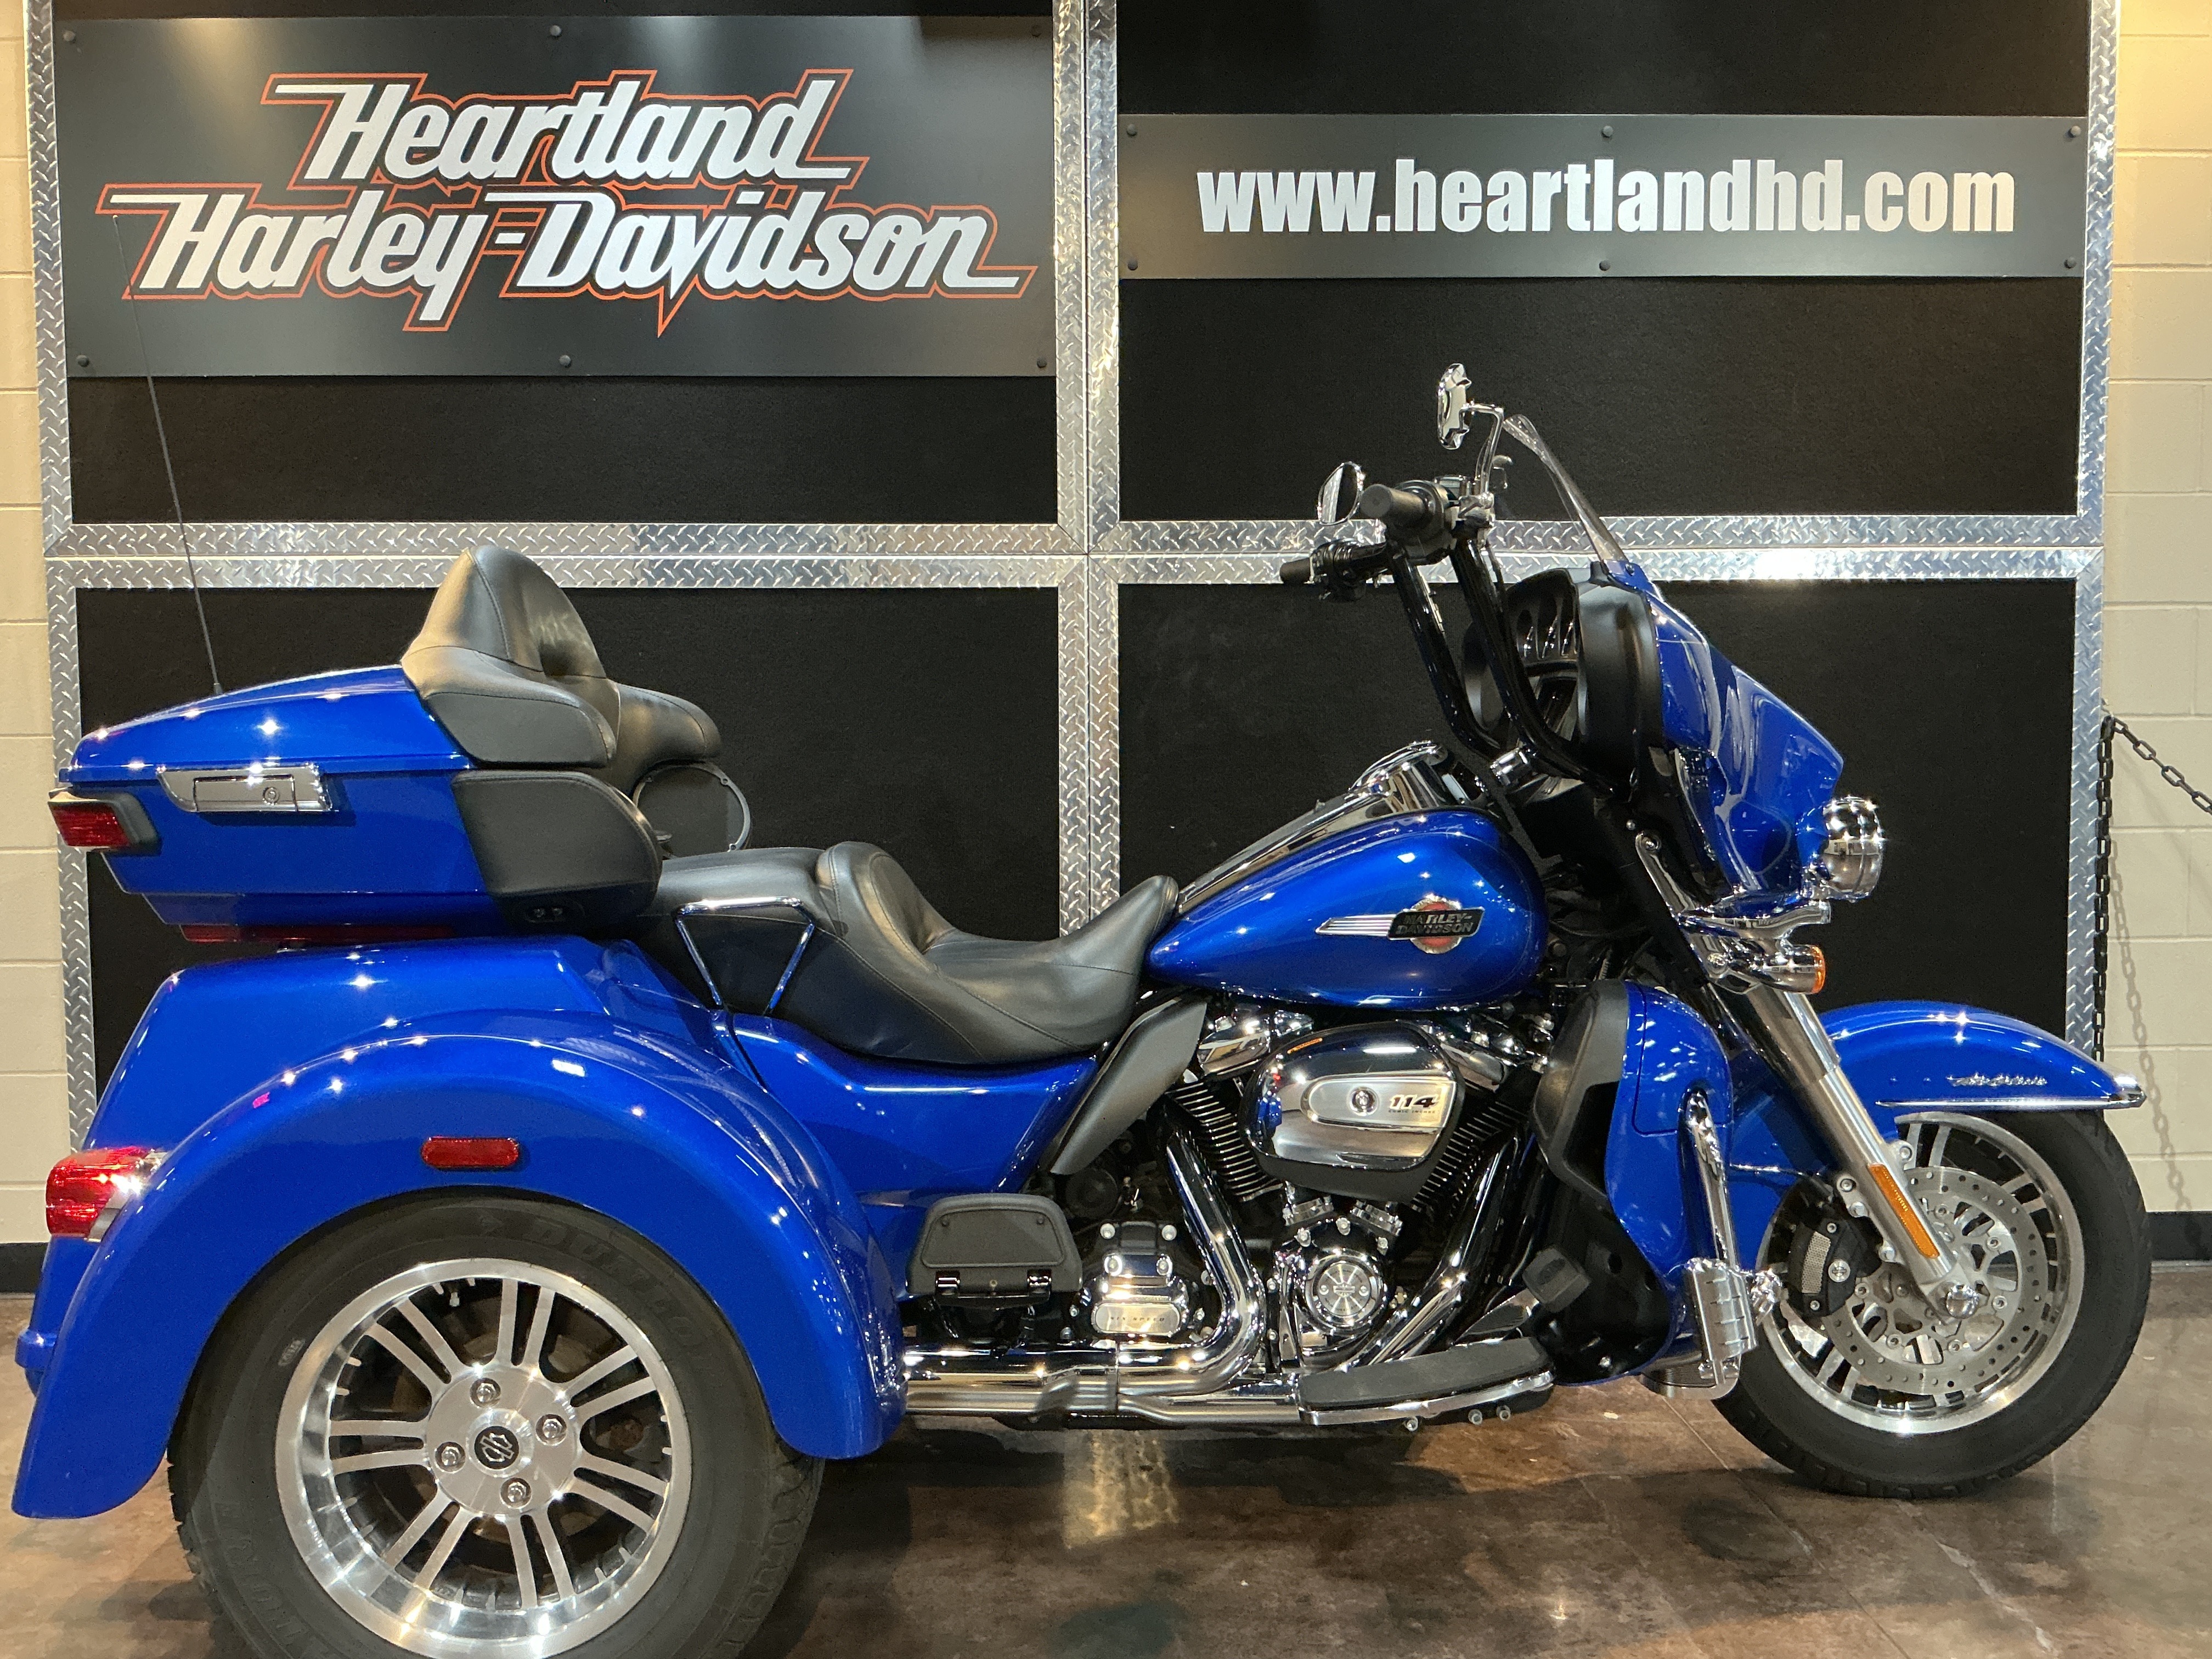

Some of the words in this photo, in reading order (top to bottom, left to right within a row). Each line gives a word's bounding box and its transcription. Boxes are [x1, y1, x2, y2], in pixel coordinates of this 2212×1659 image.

[274, 80, 851, 180] Heartland
[1196, 159, 2016, 233] www.heartlandhd.com
[109, 190, 1019, 321] Harley-Davidson
[1389, 1094, 1439, 1109] 114
